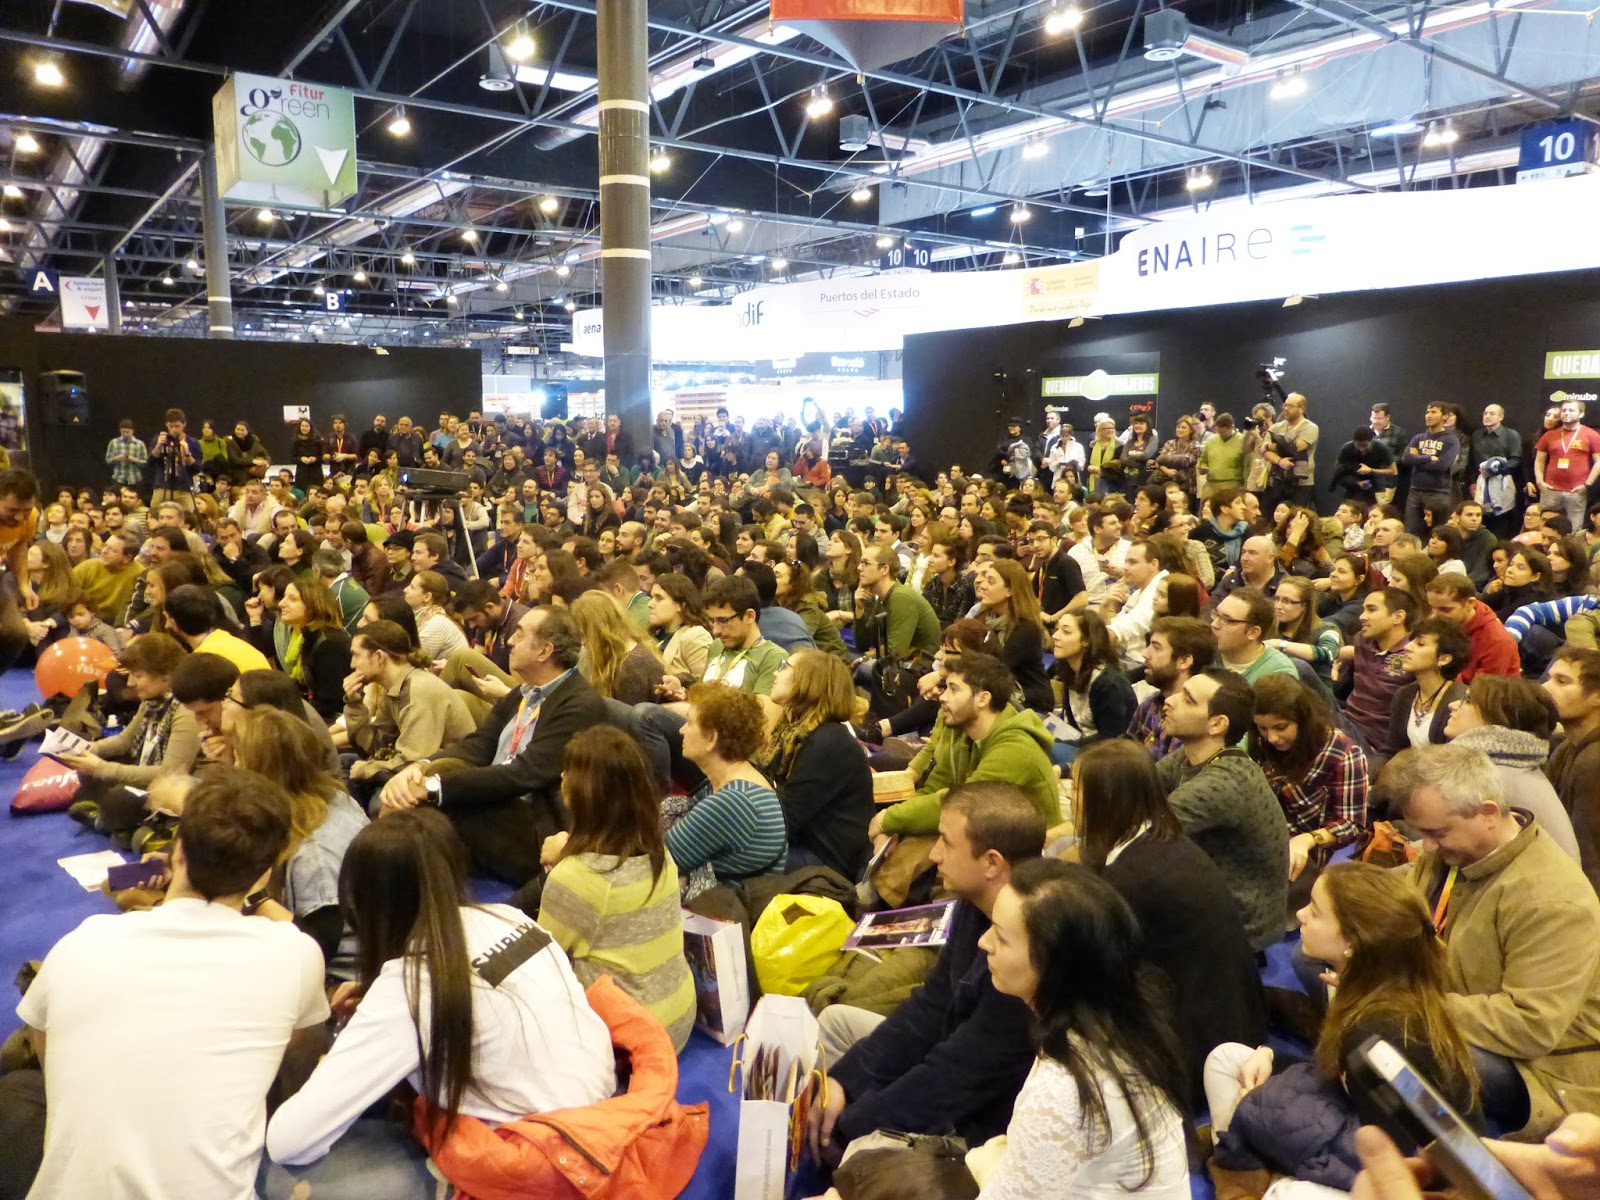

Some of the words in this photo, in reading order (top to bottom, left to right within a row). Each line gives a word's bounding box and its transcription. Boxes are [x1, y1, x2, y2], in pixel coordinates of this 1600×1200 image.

[289, 84, 325, 100] Fitur
[1539, 132, 1575, 162] 10
[887, 249, 901, 266] 10
[913, 249, 928, 266] 10
[32, 271, 54, 291] A
[326, 292, 340, 310] B
[820, 292, 858, 303] Puertos
[860, 289, 877, 300] del
[880, 287, 920, 300] Estado
[583, 323, 601, 335] aena
[1566, 392, 1598, 401] minube
